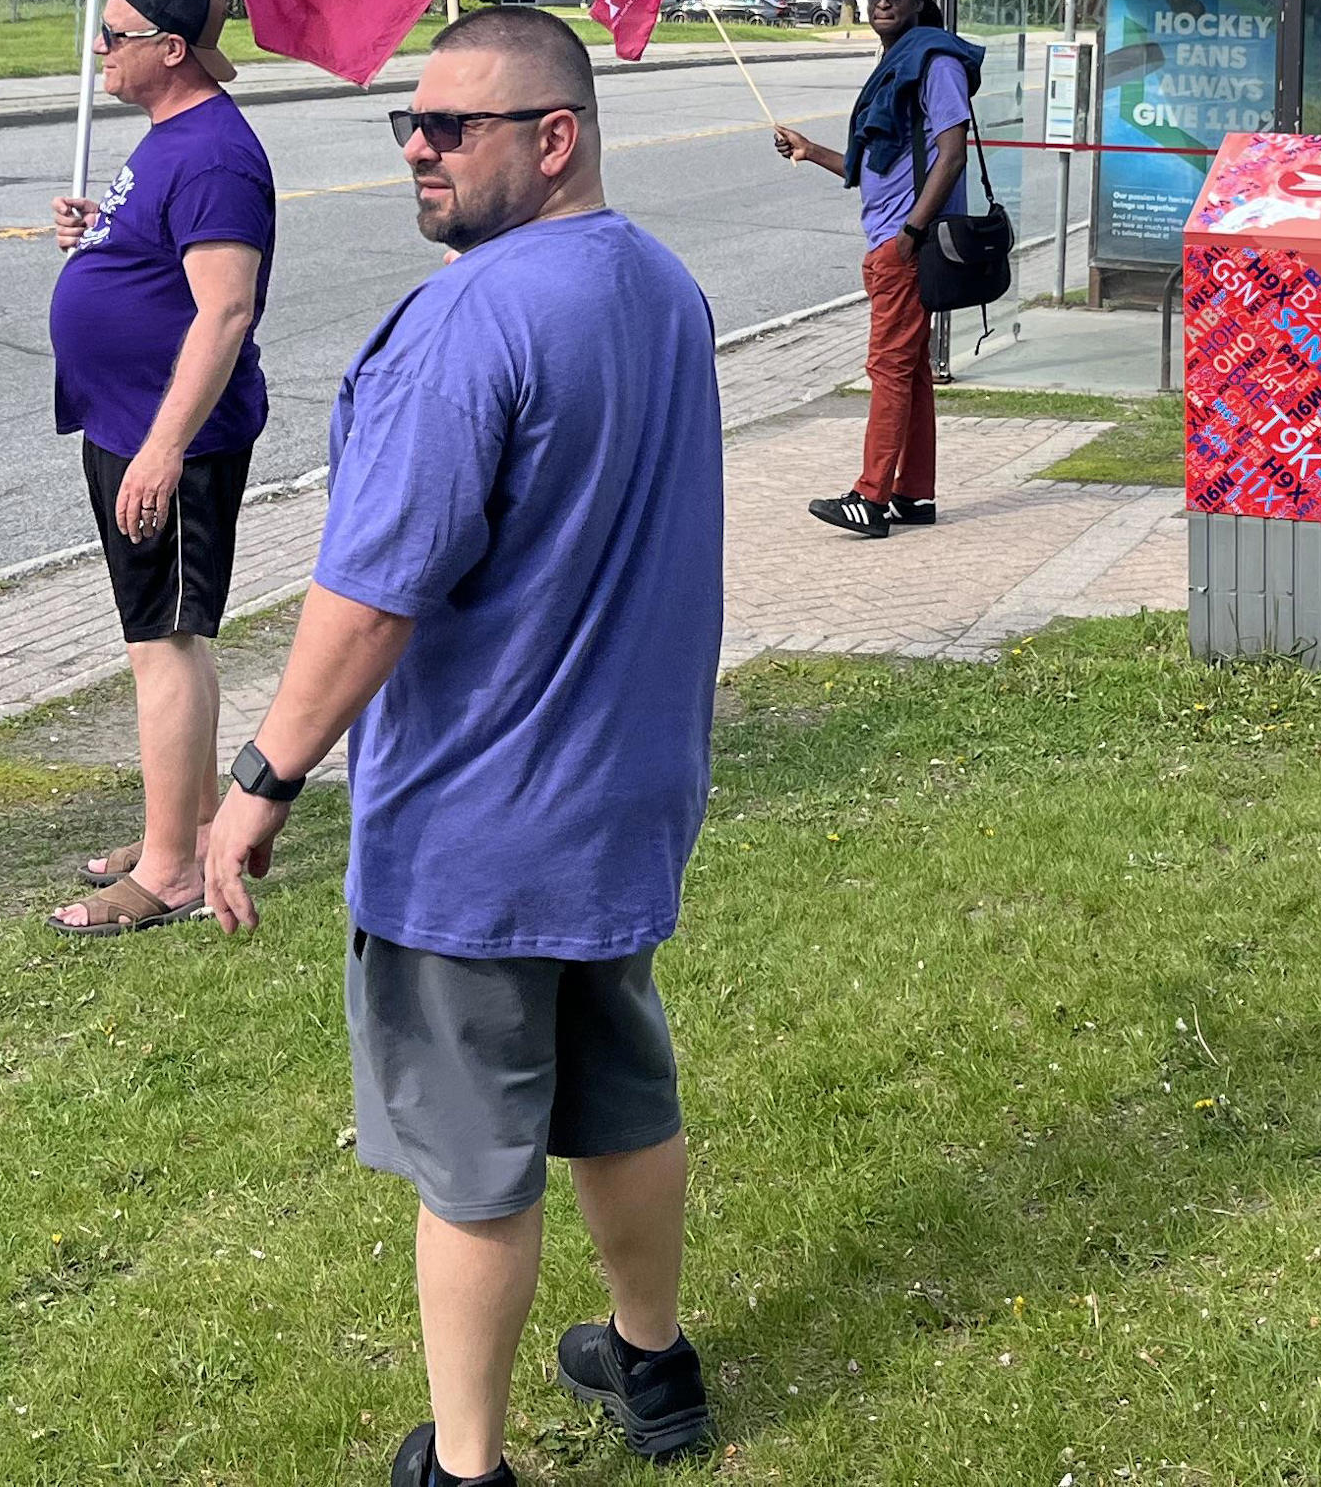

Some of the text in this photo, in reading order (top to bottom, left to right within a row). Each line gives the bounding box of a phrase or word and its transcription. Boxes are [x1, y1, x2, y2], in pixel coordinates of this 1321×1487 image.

[1154, 11, 1273, 38] HOCKEY
[1176, 43, 1247, 69] FANS
[1158, 73, 1264, 101] ALWAYS
[1133, 102, 1198, 128] GIVE
[1113, 191, 1127, 199] Our
[1188, 280, 1223, 310] T3M
[1213, 259, 1262, 306] G5N
[1247, 257, 1295, 306] H9X
[1186, 308, 1219, 343] A1B
[1198, 318, 1242, 359] HOH
[1213, 333, 1255, 373] OHO
[1263, 351, 1300, 389] V7J
[1278, 344, 1309, 373] P8T
[1227, 366, 1273, 409] B4E
[1258, 374, 1286, 395] J5T
[1300, 415, 1321, 437] A1B
[1196, 472, 1235, 507] M9L
[1227, 456, 1285, 512] H1X
[1261, 456, 1309, 505] H9X
